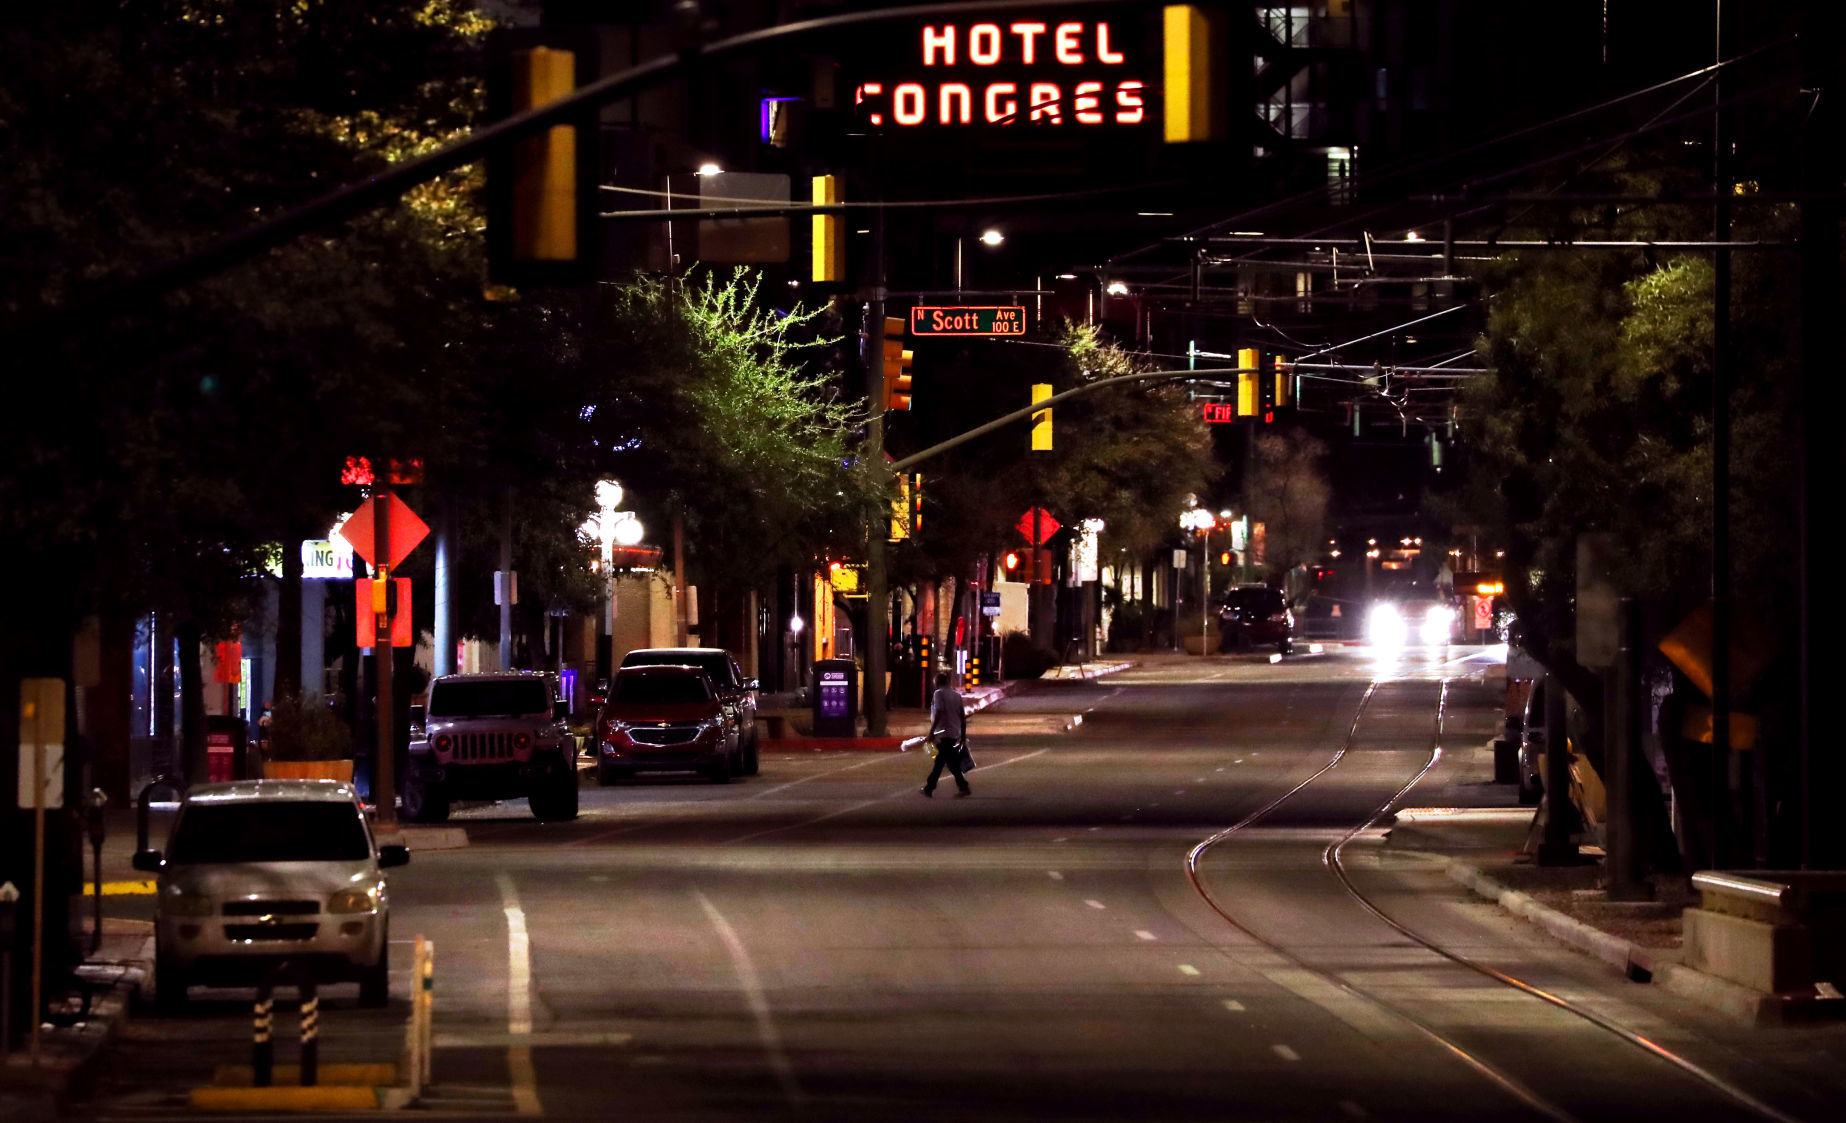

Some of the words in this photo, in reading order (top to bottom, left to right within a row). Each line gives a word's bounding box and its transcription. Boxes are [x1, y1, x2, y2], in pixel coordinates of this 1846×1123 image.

[922, 21, 1125, 66] HOTEL
[917, 309, 925, 320] N
[932, 309, 979, 332] Scott
[996, 309, 1016, 320] Ave
[992, 321, 1009, 333] 100
[1013, 321, 1020, 333] E
